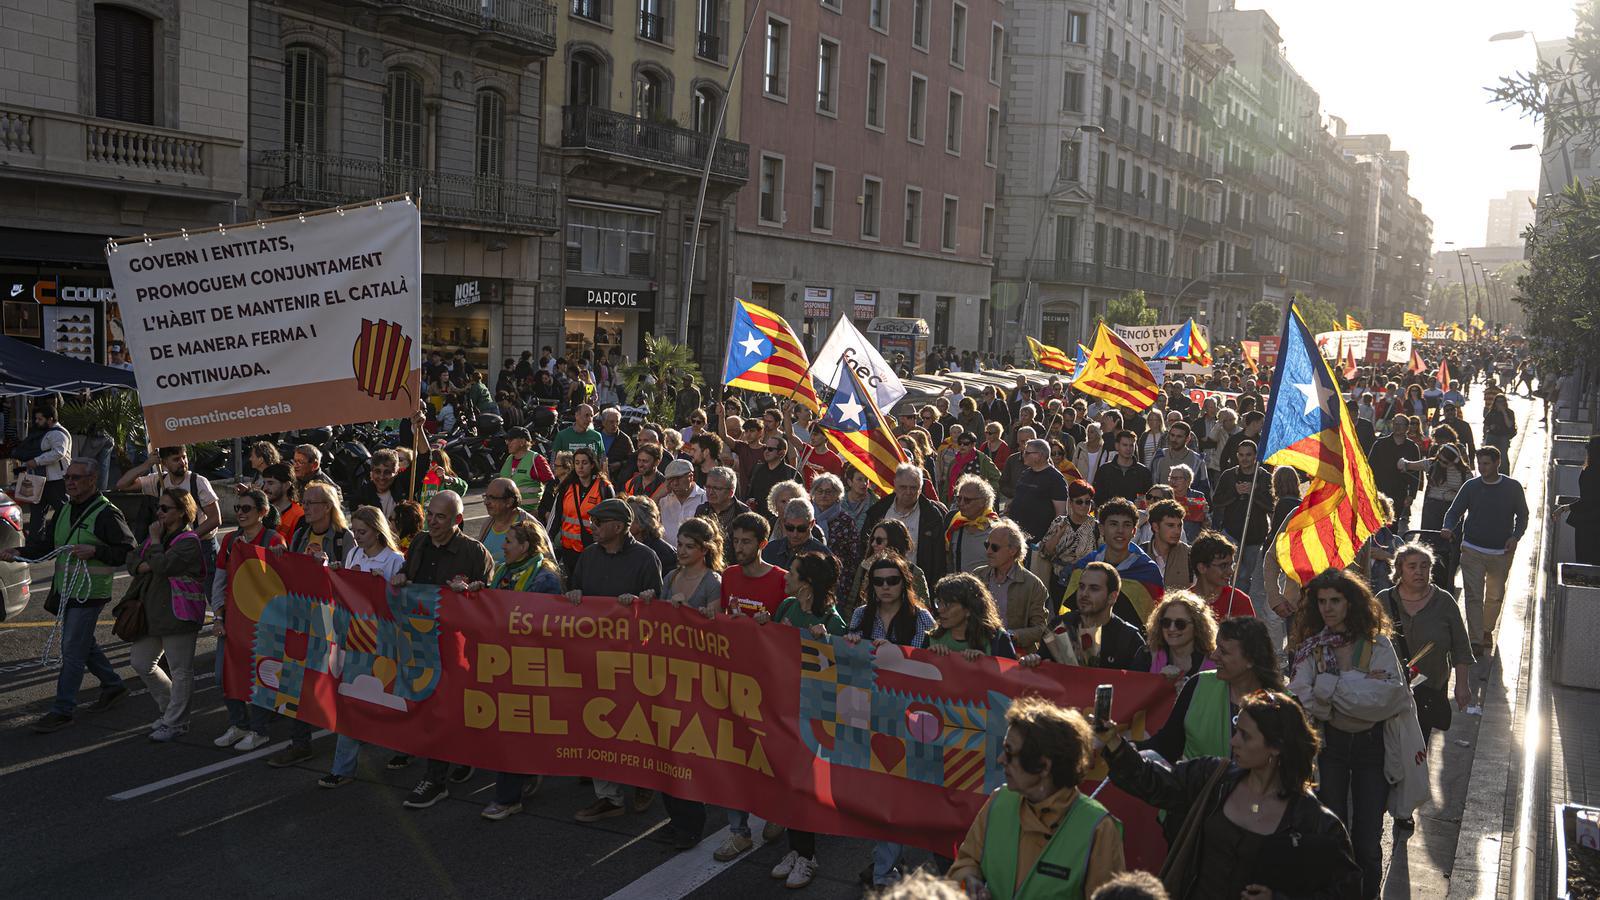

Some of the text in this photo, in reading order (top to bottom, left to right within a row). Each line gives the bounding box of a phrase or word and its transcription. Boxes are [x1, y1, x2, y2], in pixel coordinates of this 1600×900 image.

[129, 236, 295, 273] GOVERN I ENTITATS,
[62, 286, 114, 302] COUR
[136, 252, 383, 302] PROMOGUEM CONJUNTAMENT
[455, 280, 480, 300] NOEL
[143, 275, 408, 332] L'HÀBIT DE MANTENIR EL CATALÀ
[587, 290, 637, 306] PARFOIS
[149, 324, 318, 361] DE MANERA FERMA I
[1136, 343, 1156, 353] TOT
[156, 362, 271, 389] CONTINUADA.
[164, 402, 292, 432] @mantincelcatala
[508, 606, 731, 660] ÉS L'HORA D'ACTUAR
[477, 642, 764, 722] PEL FUTUR
[463, 688, 775, 778] DEL CATALÀ
[556, 747, 693, 781] SANT JORDI PER LA LLENGUA
